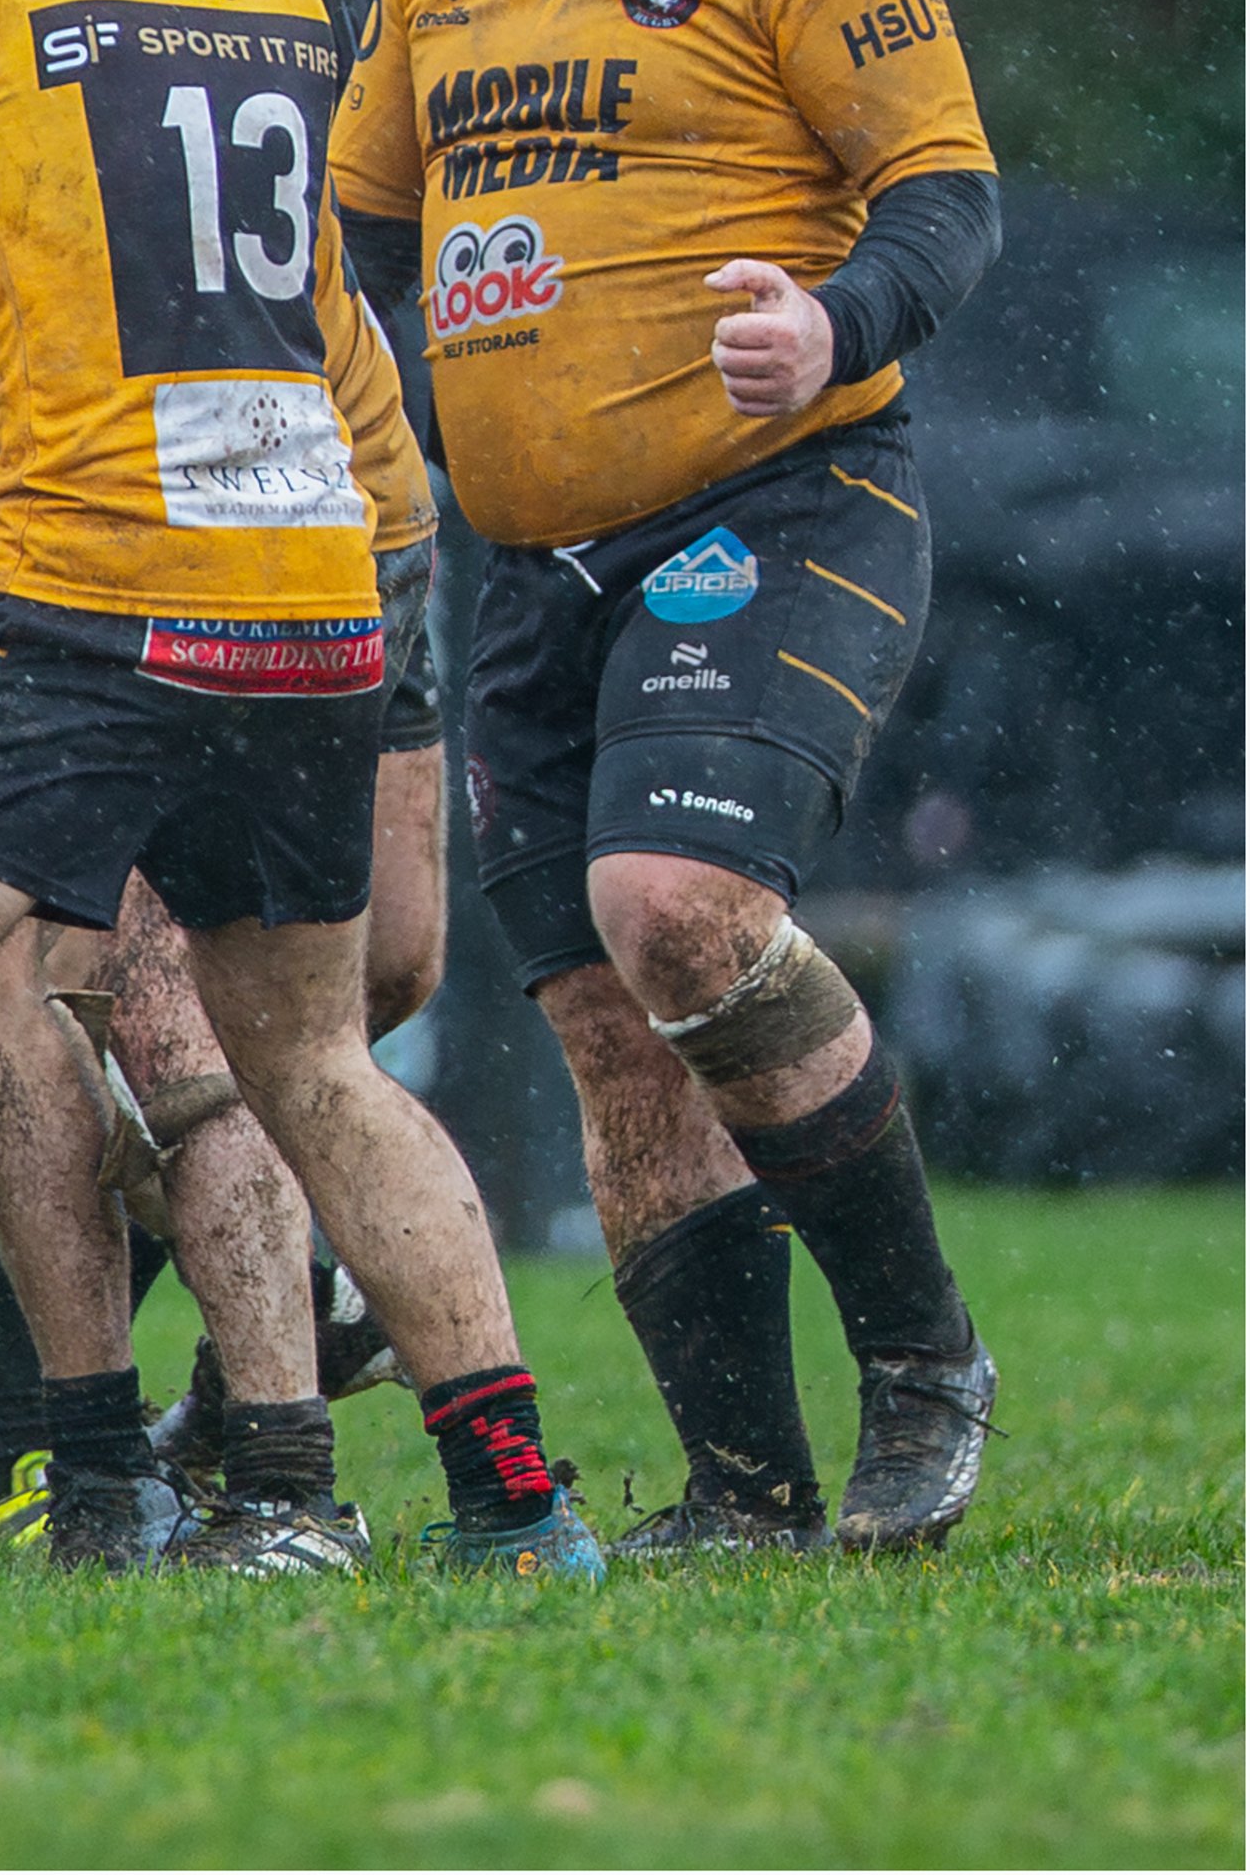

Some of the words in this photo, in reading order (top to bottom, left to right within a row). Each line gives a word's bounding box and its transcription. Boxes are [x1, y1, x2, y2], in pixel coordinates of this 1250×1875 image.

[137, 27, 251, 61] SPORT
[259, 37, 287, 64] IT
[293, 41, 339, 80] FIRS
[428, 59, 637, 145] MOBILE
[162, 86, 310, 301] 13
[443, 137, 619, 202] MEDIA
[432, 259, 558, 331] LOOK
[467, 328, 540, 357] STORAGE
[176, 618, 382, 638] BOURNEMOUT
[170, 639, 350, 671] SCAFFOLDING
[681, 790, 755, 823] Sondico
